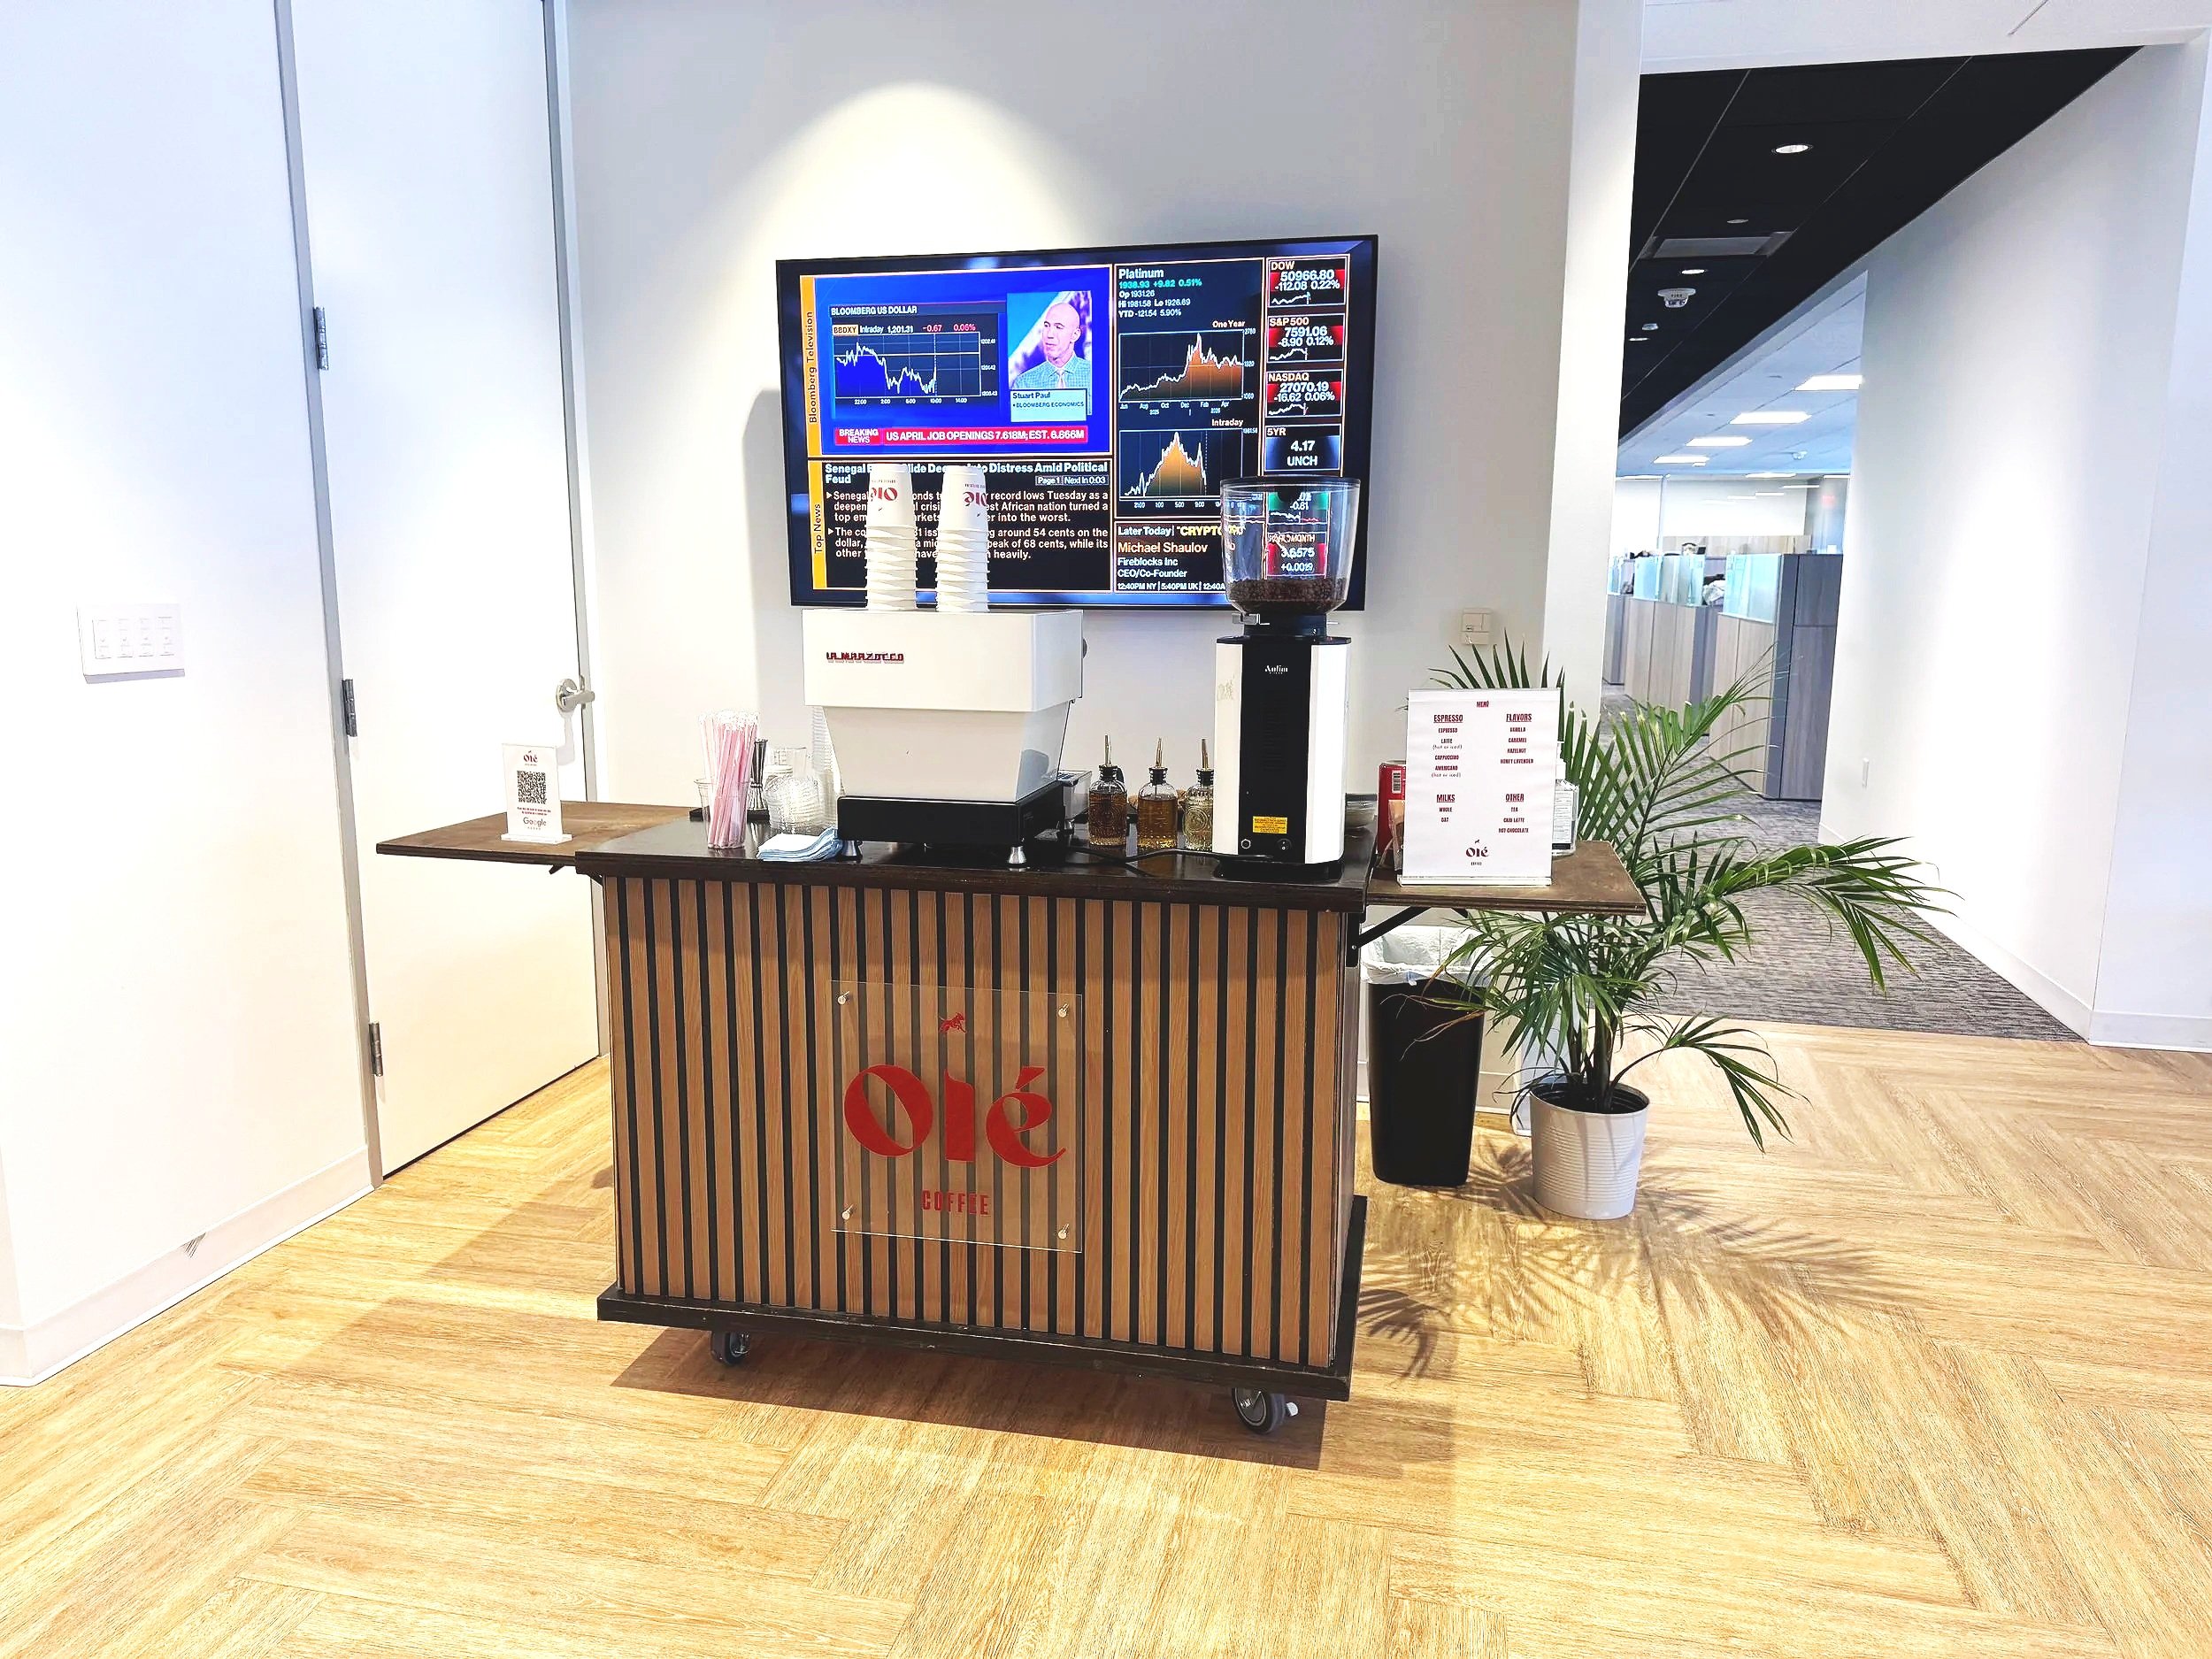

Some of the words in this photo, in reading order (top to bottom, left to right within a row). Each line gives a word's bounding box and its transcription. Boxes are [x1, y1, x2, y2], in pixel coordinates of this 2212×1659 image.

[1271, 261, 1294, 270] DOW
[1119, 268, 1164, 279] Platinum
[1280, 269, 1335, 281] 50966.80
[1275, 281, 1307, 291] -112.08
[1311, 279, 1340, 289] 0.22%
[831, 307, 876, 316] BLOOMBERG
[877, 306, 887, 315] US
[888, 306, 917, 314] DOLLAR
[1269, 318, 1289, 326] S&P
[1290, 317, 1309, 326] 500
[860, 325, 883, 334] Intraday
[1285, 326, 1328, 337] 7591.06
[806, 311, 815, 363] Television
[1278, 338, 1303, 347] -8.90
[1306, 336, 1334, 346] 0.12%
[1268, 373, 1309, 381] NASDAQ
[1279, 381, 1329, 392] 27070.19
[1274, 393, 1302, 402] -16.62
[1305, 391, 1335, 401] 0.06%
[1212, 419, 1244, 427] Intraday
[887, 432, 899, 441] US
[900, 431, 926, 440] APRIL
[927, 431, 946, 440] JOB
[947, 431, 994, 440] OPENINGS
[1029, 430, 1050, 439] EST.
[1291, 440, 1315, 451] 4.17
[1287, 456, 1318, 466] UNCH
[826, 464, 866, 475] Senegal
[989, 463, 1033, 472] Distress
[1034, 462, 1062, 472] Amid
[1064, 461, 1107, 472] Political
[826, 474, 851, 484] Feud
[991, 491, 1021, 500] record
[1023, 491, 1045, 500] lows
[1047, 491, 1086, 501] Tuesday
[1002, 502, 1035, 511] African
[1037, 502, 1066, 511] nation
[1069, 501, 1099, 510] turned
[834, 512, 851, 523] top
[998, 513, 1017, 522] into
[1020, 512, 1037, 522] the
[1040, 513, 1071, 522] worst.
[835, 527, 853, 536] The
[1118, 526, 1142, 536] Later
[814, 535, 824, 554] Top
[835, 538, 864, 548] dollar,
[987, 539, 1009, 550] peak
[1024, 539, 1036, 548] 68
[1038, 540, 1067, 549] cents,
[1069, 539, 1094, 548] while
[1096, 539, 1108, 547] its
[1118, 542, 1160, 553] Michael
[1164, 542, 1208, 553] Shaulov
[836, 549, 862, 557] other
[994, 550, 1031, 560] heavily.
[1118, 557, 1163, 566] Fireblocks
[1164, 557, 1178, 566] Inc
[1118, 569, 1187, 578] CEO/Co-Founder
[1436, 794, 1455, 803] MILKS
[523, 817, 546, 827] Google
[1466, 847, 1489, 857] Olé
[844, 1064, 1066, 1168] Olé
[921, 1190, 990, 1215] COFFEE
